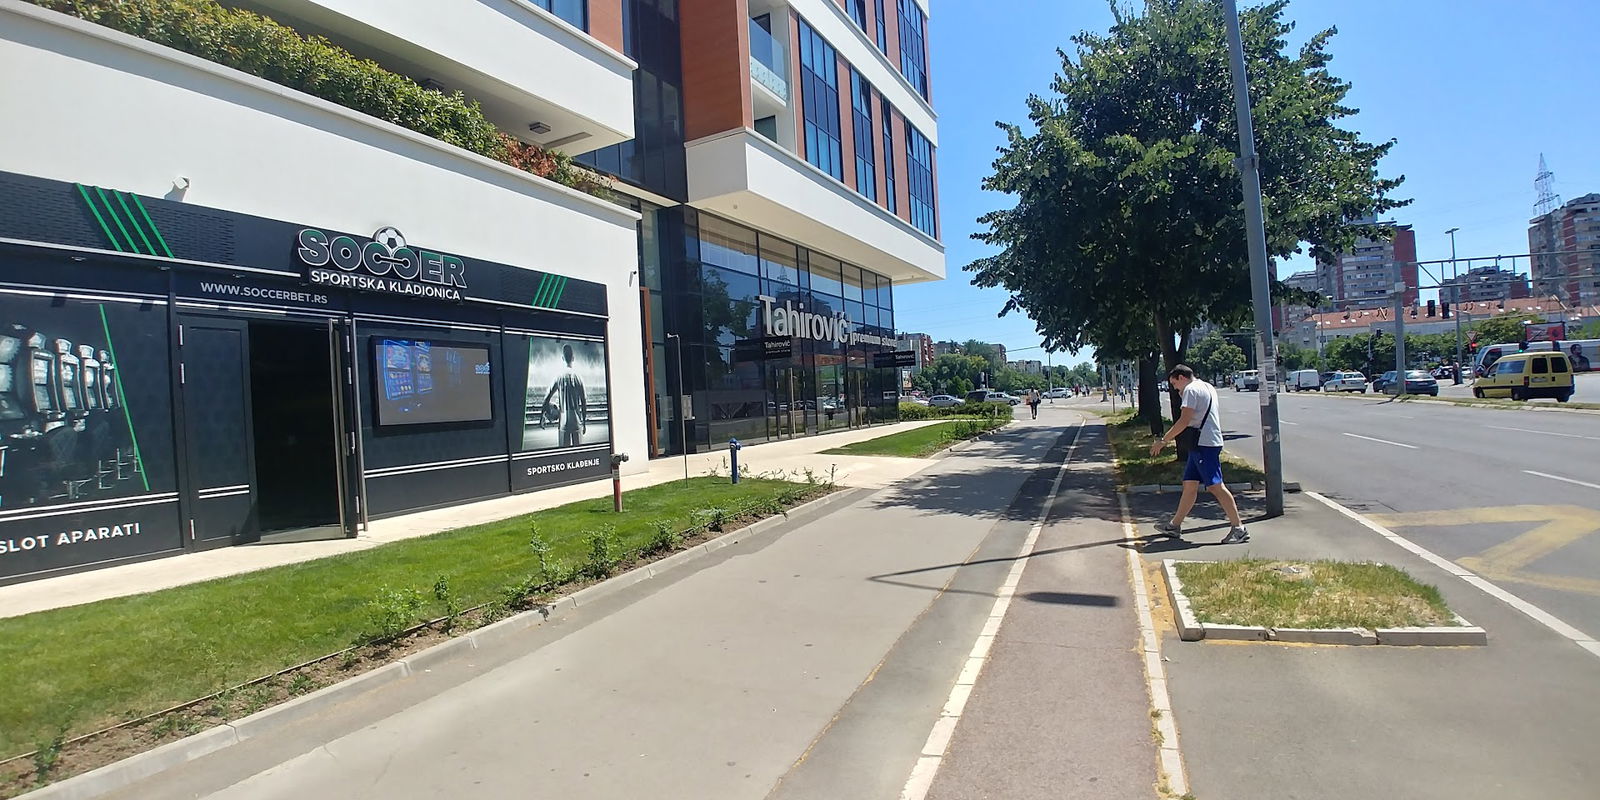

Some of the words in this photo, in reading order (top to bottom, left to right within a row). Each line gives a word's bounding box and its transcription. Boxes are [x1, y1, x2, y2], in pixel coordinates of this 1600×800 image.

[297, 228, 468, 289] SOCCER
[200, 282, 328, 304] WWW.SOCCERBET.RS
[311, 270, 386, 292] SPORTSKA
[389, 282, 461, 300] KLADIONICA
[758, 294, 848, 344] Tahirović
[527, 463, 565, 476] SPORTSKO
[0, 535, 49, 554] SLOT
[57, 522, 140, 546] APARATI
